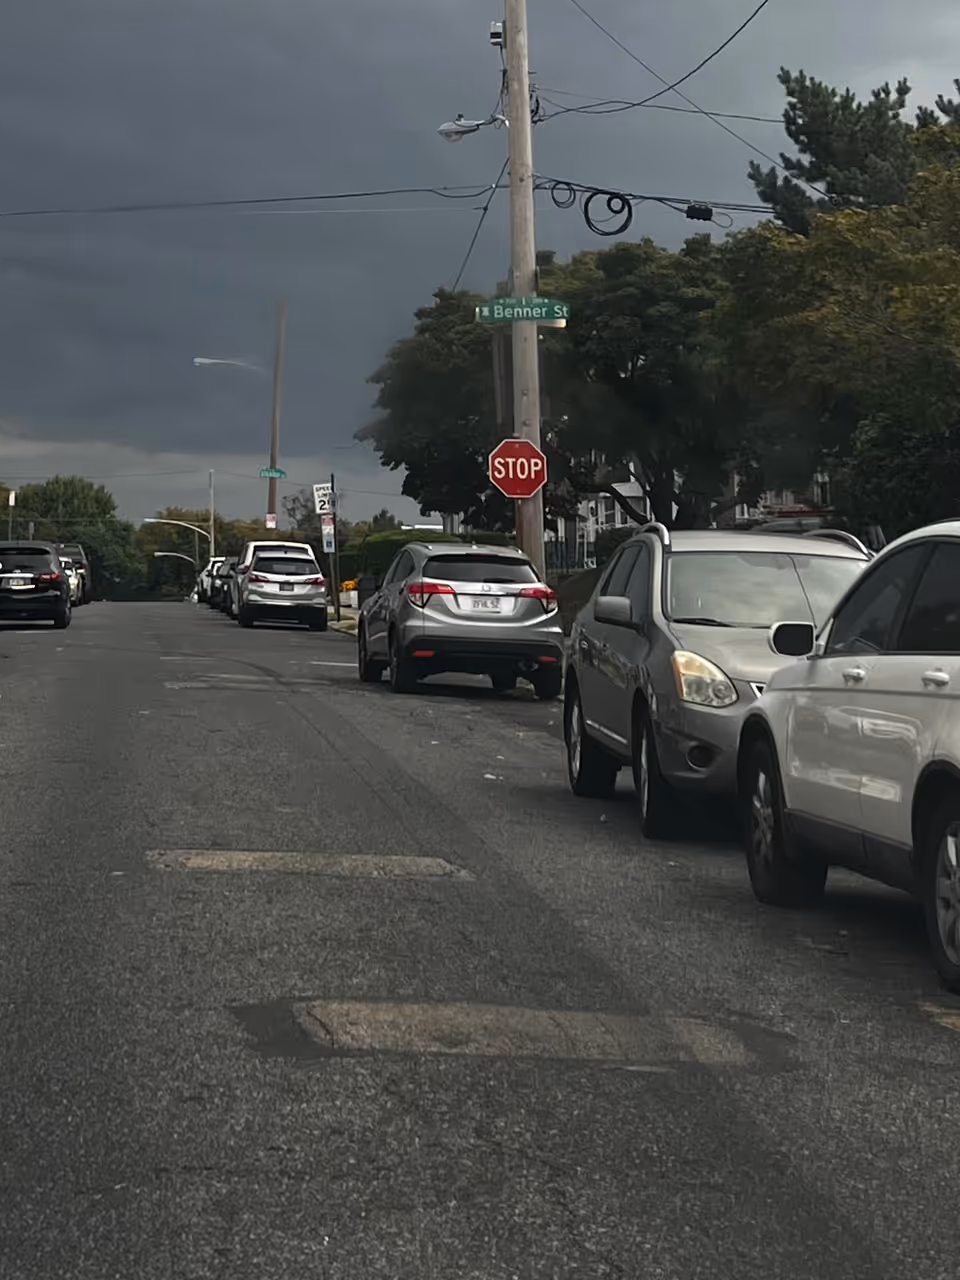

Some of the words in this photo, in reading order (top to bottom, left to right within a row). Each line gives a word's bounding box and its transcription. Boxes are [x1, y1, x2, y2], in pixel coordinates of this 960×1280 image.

[494, 305, 547, 318] Benner
[553, 305, 568, 317] St
[494, 457, 542, 479] STOP
